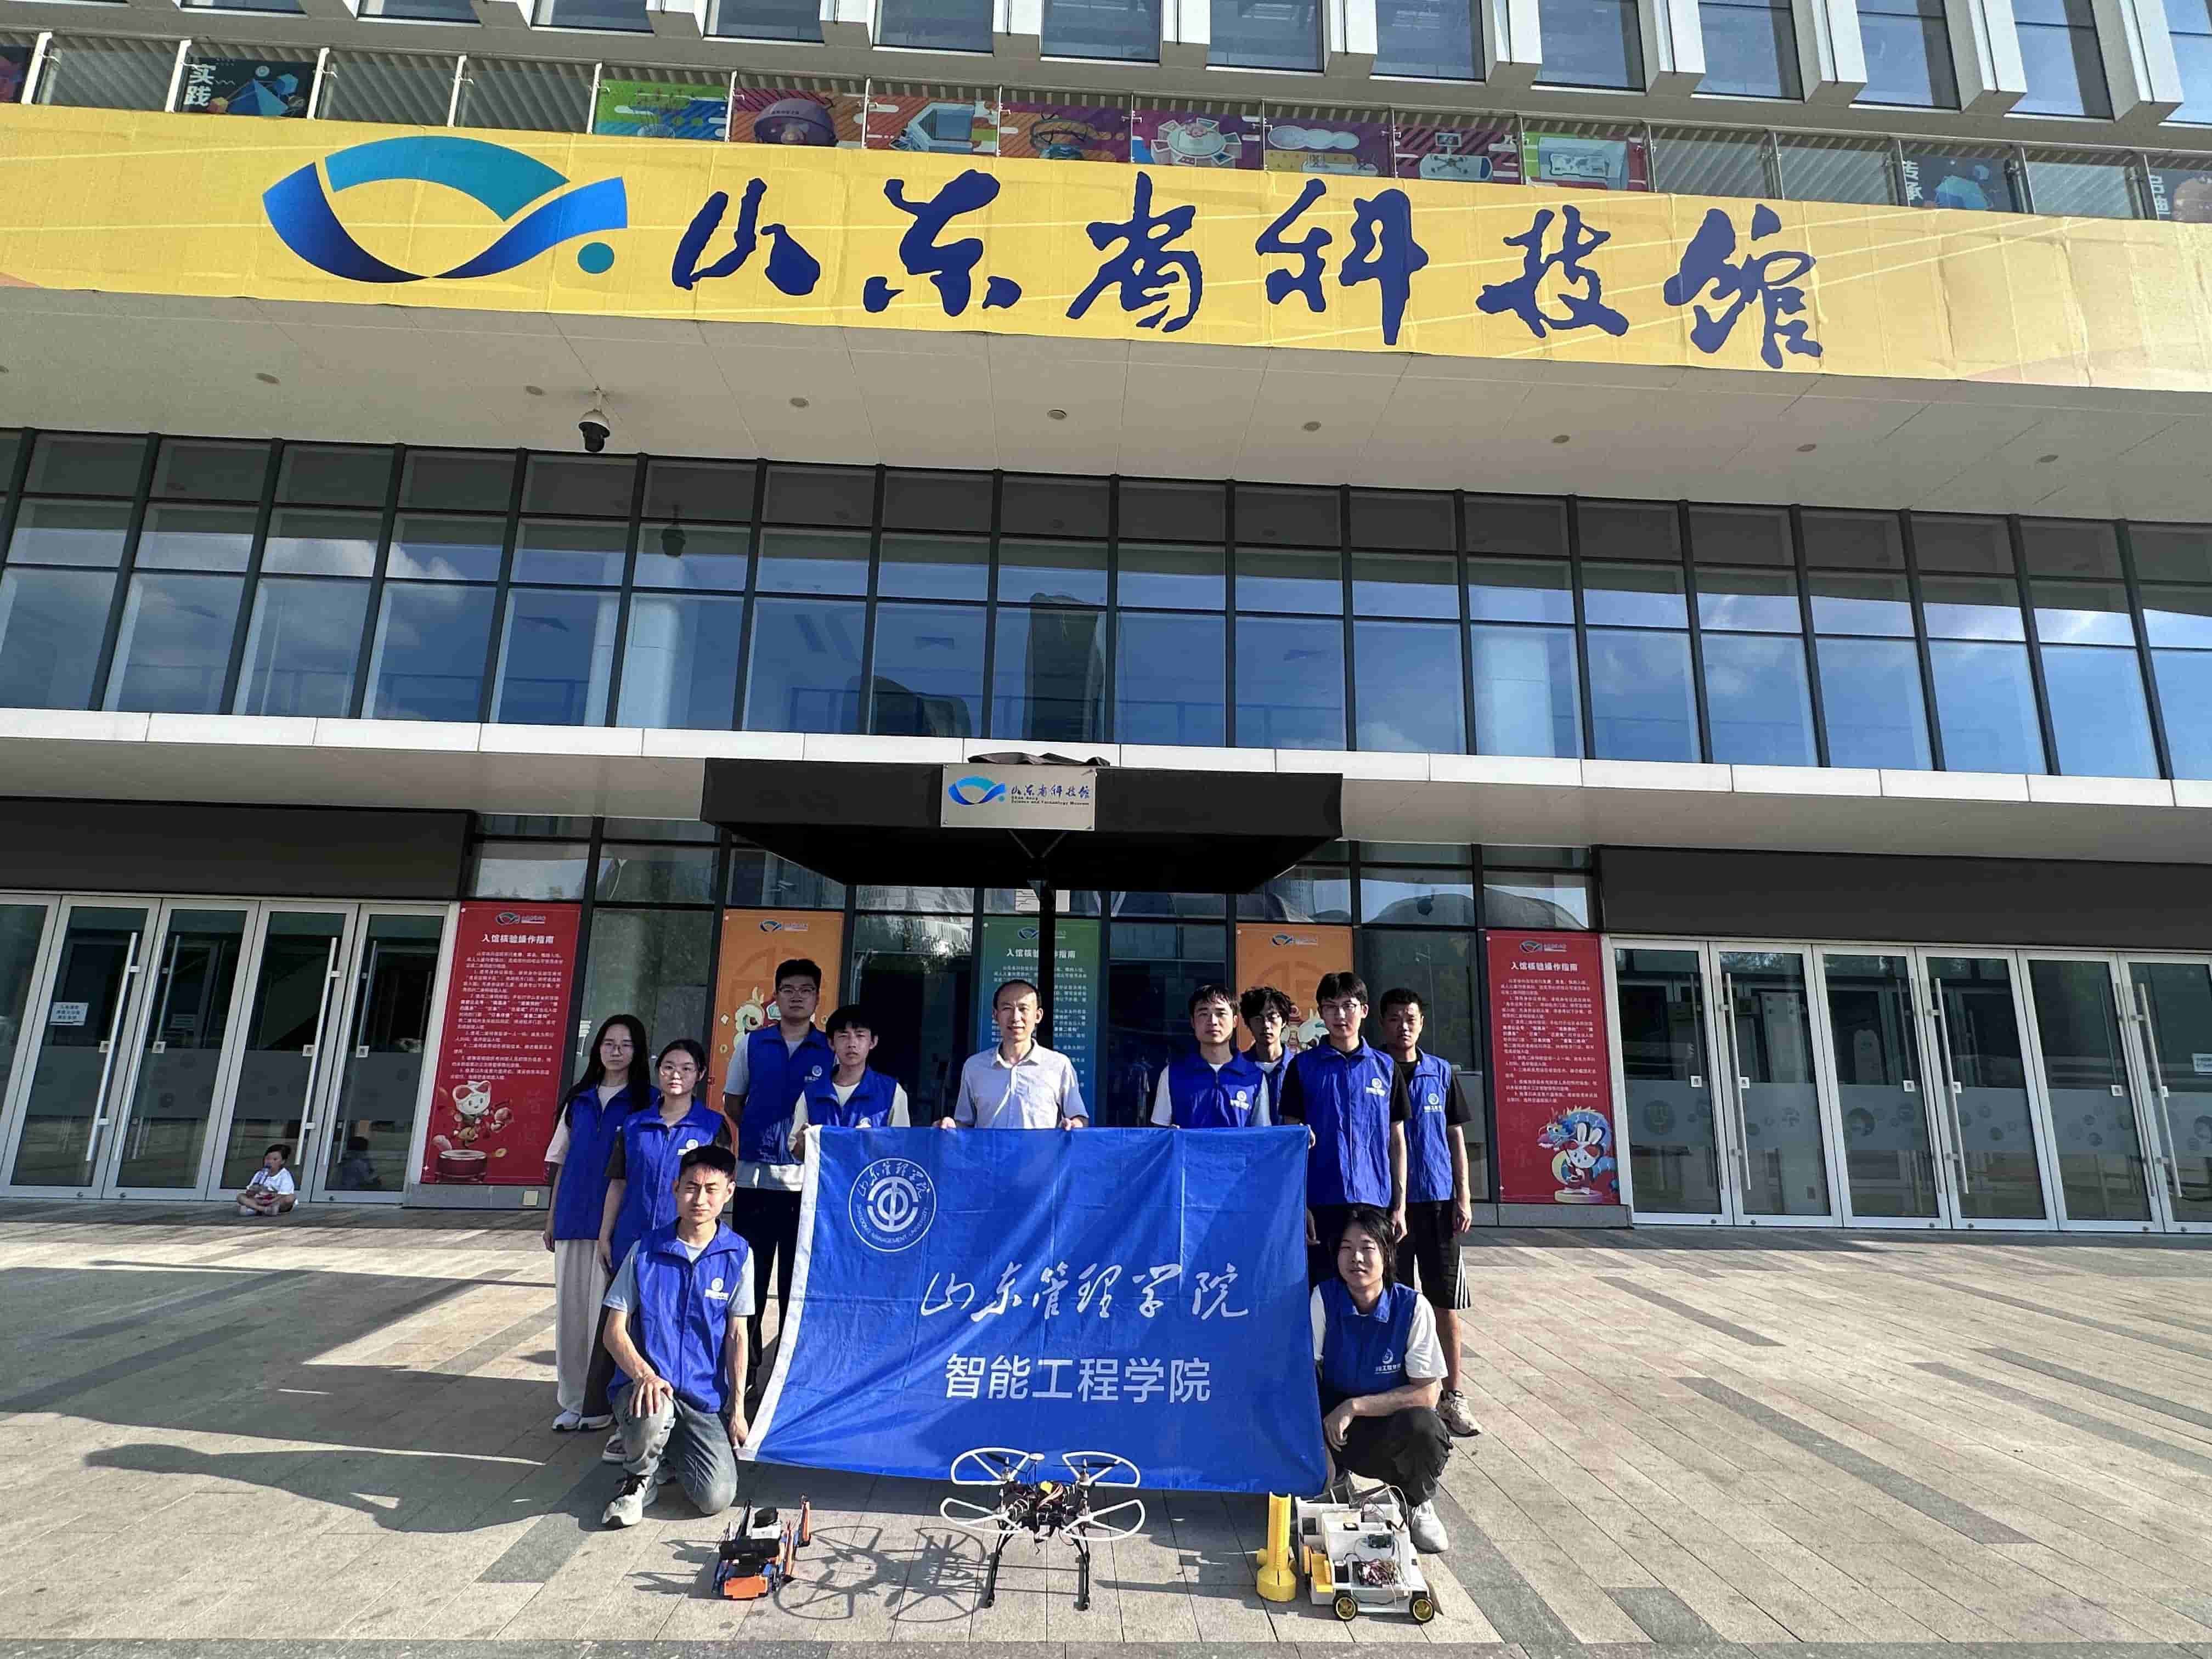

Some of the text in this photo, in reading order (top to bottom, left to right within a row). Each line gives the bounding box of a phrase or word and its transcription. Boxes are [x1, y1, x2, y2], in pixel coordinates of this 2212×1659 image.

[672, 170, 1824, 369] 山东省科技馆
[1011, 784, 1089, 797] 山东省科技馆
[921, 1261, 1250, 1322] 山东管理学院
[945, 1353, 1211, 1403] 智能工程学院
